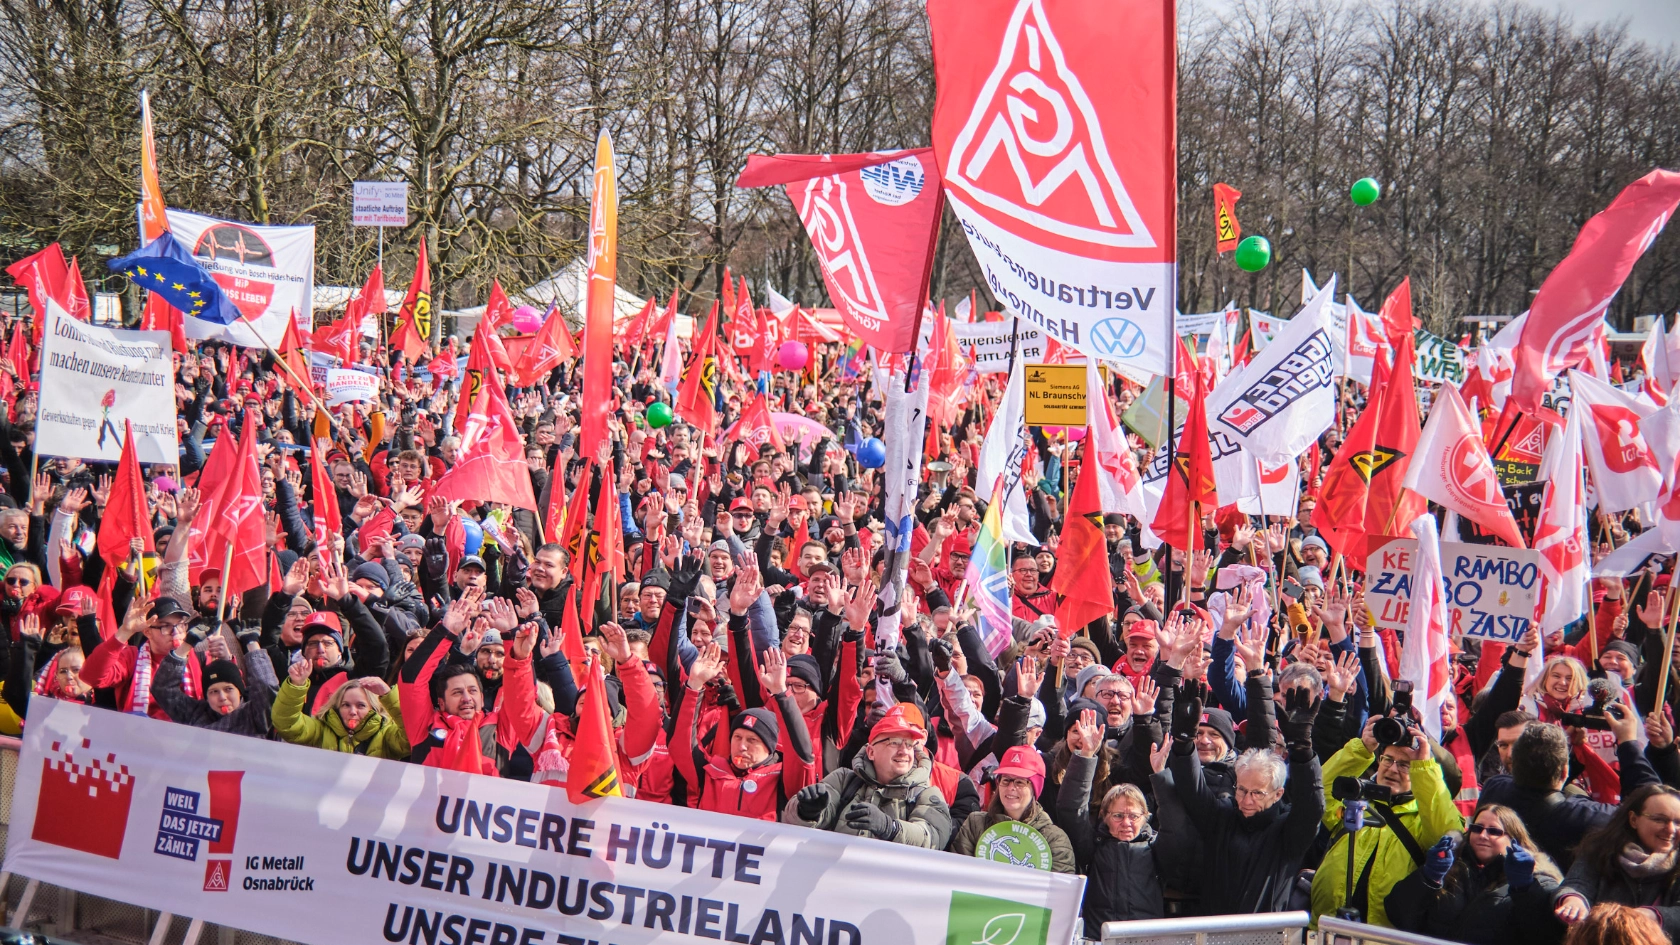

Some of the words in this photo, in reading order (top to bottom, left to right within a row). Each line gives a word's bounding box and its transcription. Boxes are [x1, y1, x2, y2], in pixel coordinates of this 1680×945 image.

[355, 186, 378, 197] Unify
[355, 205, 381, 213] staatliche
[383, 205, 405, 214] Aufträge
[374, 214, 405, 225] Tarifbindung
[249, 270, 267, 279] Bosch
[222, 288, 240, 300] USS
[241, 292, 267, 305] LEBEN
[925, 330, 1039, 347] Vauensleute
[976, 347, 1041, 363] EITLAER
[50, 351, 91, 374] machen
[90, 361, 121, 381] unsere
[329, 380, 369, 388] HANDELN
[1029, 391, 1041, 399] NL
[1042, 391, 1087, 400] Braunschw
[41, 408, 82, 428] Gewerkschaften
[82, 418, 97, 430] gegen
[148, 422, 160, 434] und
[159, 423, 175, 438] Krieg
[1507, 463, 1533, 476] Bock
[1439, 446, 1451, 482] Hamburger
[1445, 483, 1481, 513] Energienetze
[1380, 596, 1463, 636] LIER
[166, 792, 194, 810] WEIL
[162, 814, 186, 831] DAS
[186, 819, 220, 839] JETZT
[157, 835, 194, 858] ZÄHLT.
[435, 795, 596, 858] UNSERE
[605, 821, 766, 885] HÜTTE
[1011, 823, 1030, 836] WIR
[1028, 831, 1046, 851] SIND
[1040, 852, 1049, 870] DER
[245, 856, 259, 870] IG
[262, 855, 305, 871] Metall
[243, 876, 315, 891] Osnabrück
[347, 836, 475, 897] UNSER
[481, 862, 862, 945] INDUSTRIELAND
